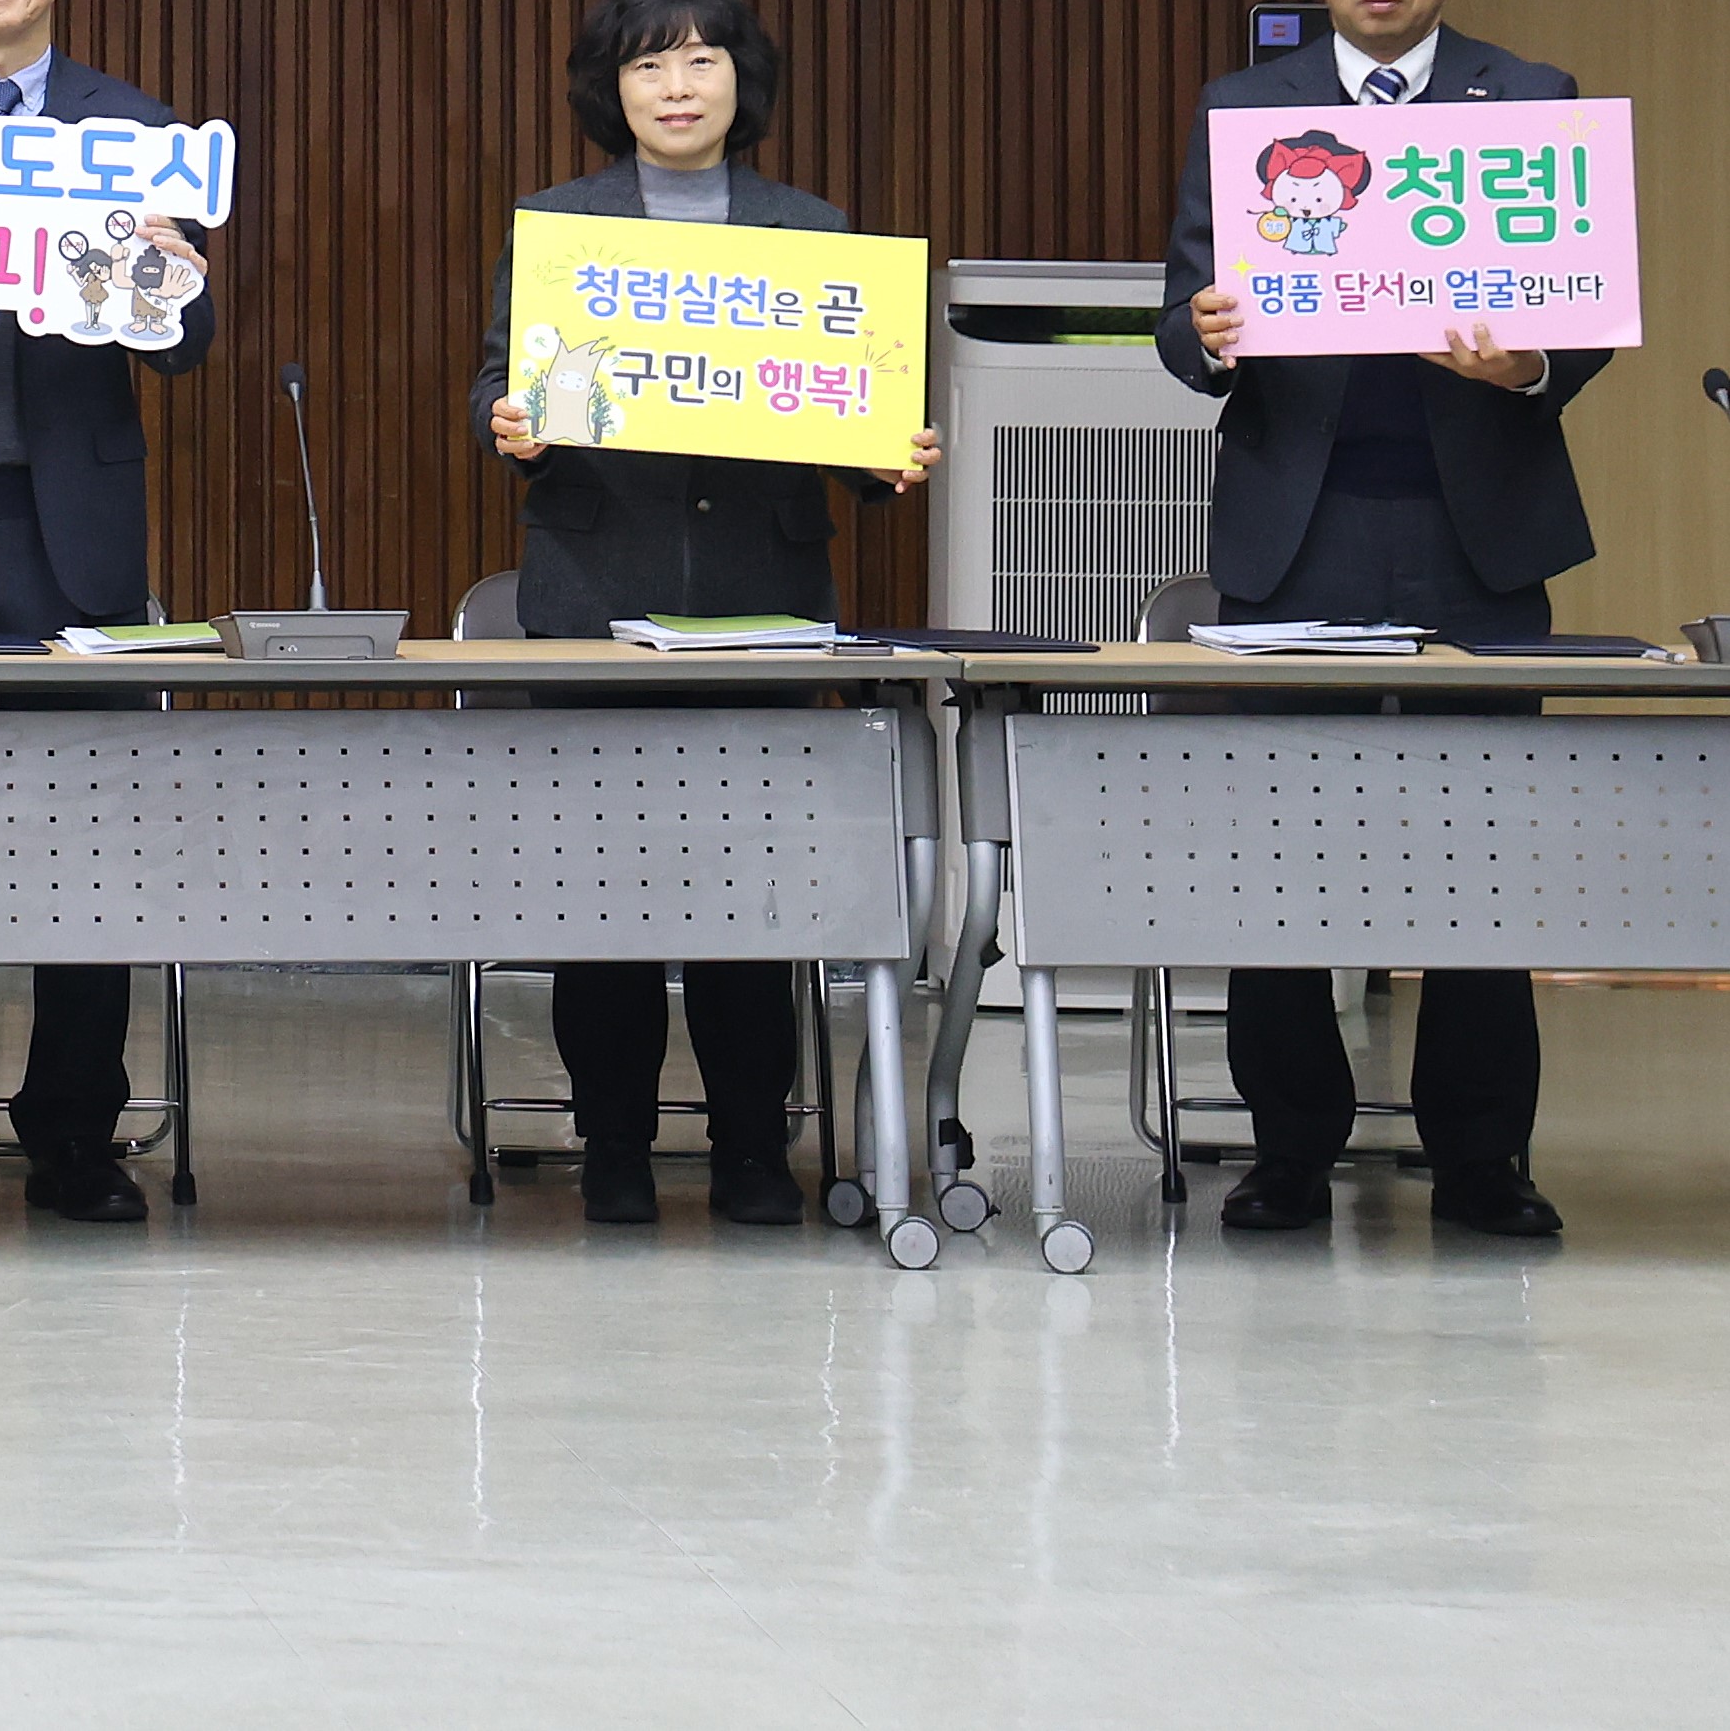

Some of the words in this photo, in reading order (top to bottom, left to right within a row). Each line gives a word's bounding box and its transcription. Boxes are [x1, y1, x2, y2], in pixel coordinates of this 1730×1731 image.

[1384, 145, 1592, 247] 청렴!
[575, 264, 803, 328] 청렴실천은
[817, 283, 864, 335] 곧
[1251, 273, 1323, 315] 명품
[1333, 271, 1434, 313] 달서의
[1445, 269, 1605, 310] 얼굴입니다
[613, 351, 742, 404] 구민의
[758, 359, 868, 417] 행복!
